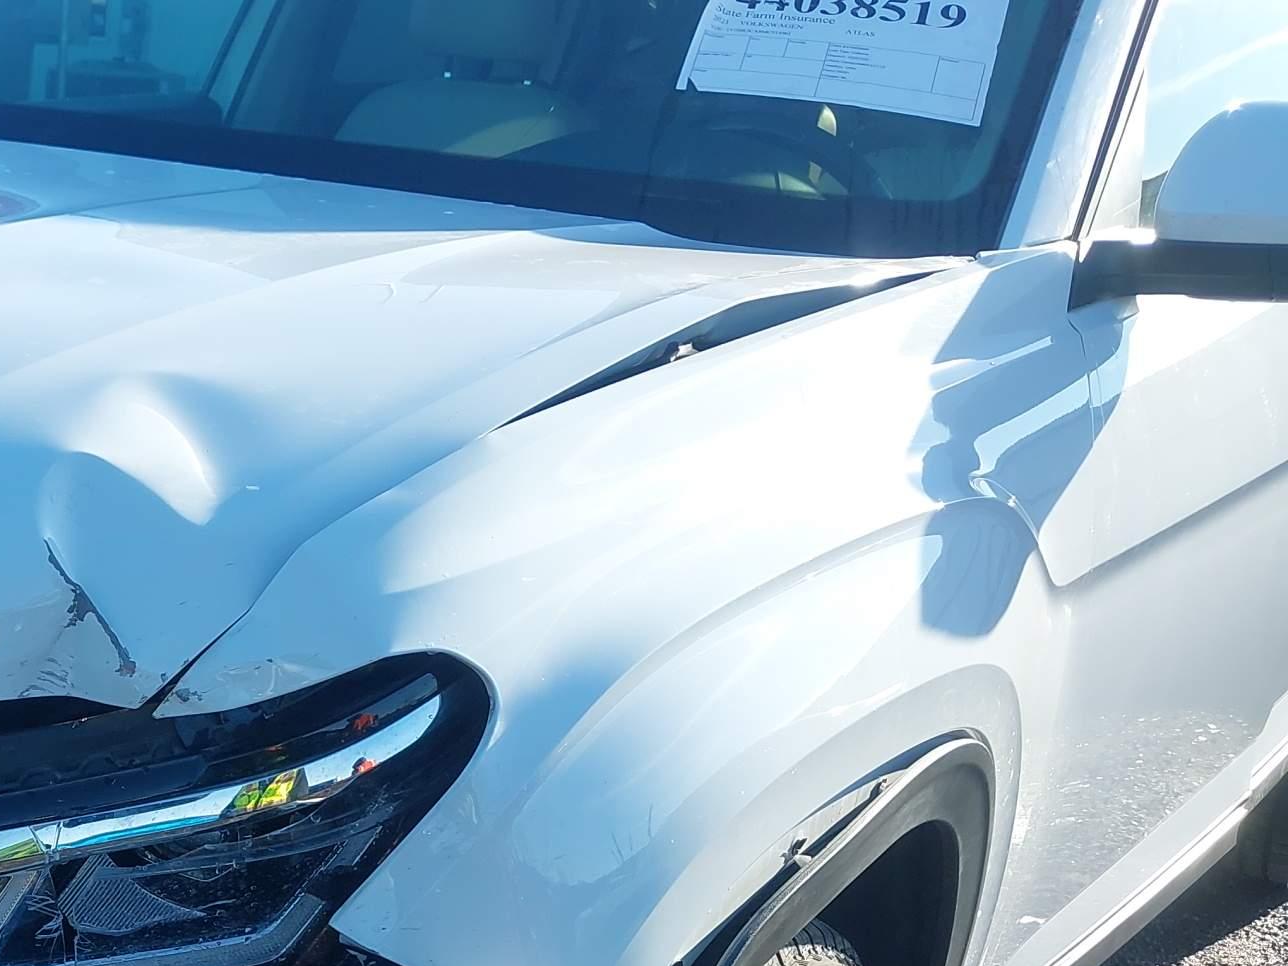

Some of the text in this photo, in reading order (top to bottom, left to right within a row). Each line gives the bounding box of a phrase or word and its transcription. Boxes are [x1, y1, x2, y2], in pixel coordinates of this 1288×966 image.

[715, 4, 836, 25] State Farm Insurance
